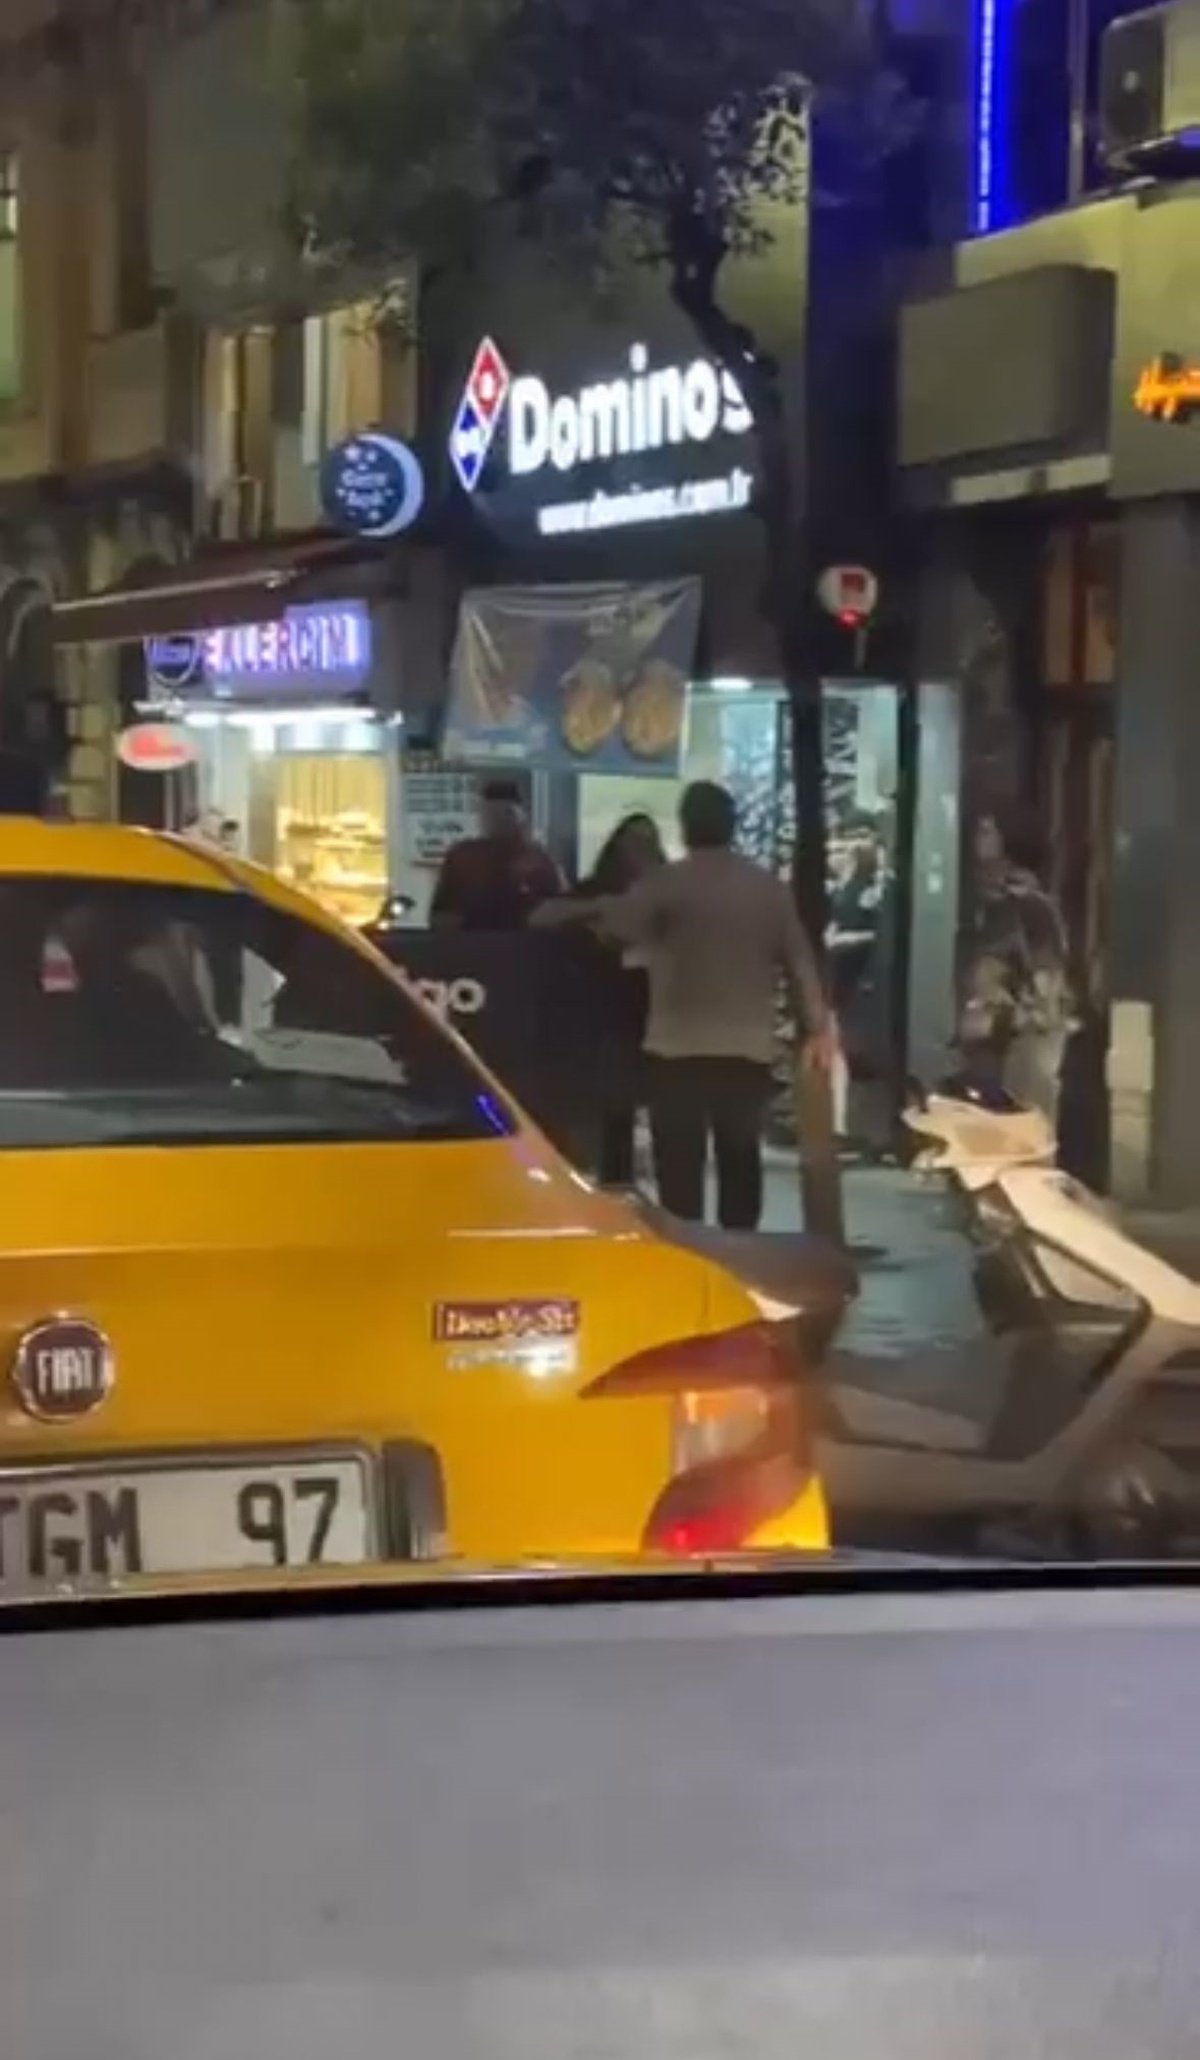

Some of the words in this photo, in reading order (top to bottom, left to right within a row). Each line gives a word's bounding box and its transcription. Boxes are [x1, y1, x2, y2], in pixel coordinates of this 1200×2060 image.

[509, 342, 753, 475] Dominos
[37, 1346, 95, 1396] FIAT
[237, 1476, 339, 1567] 97
